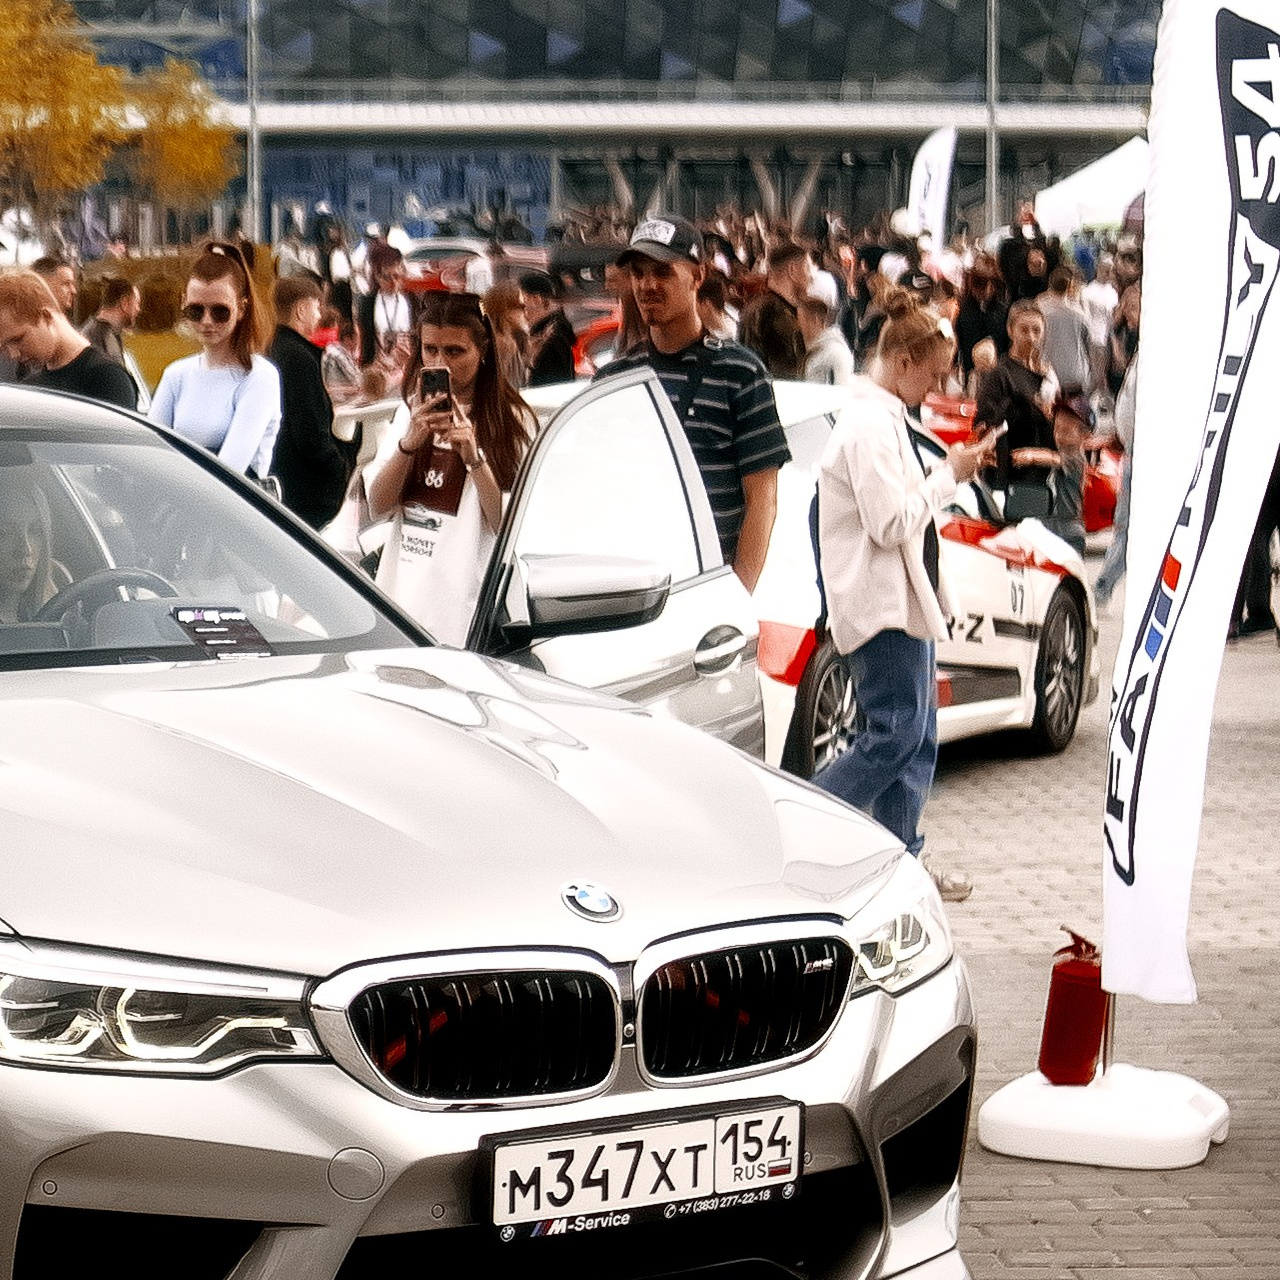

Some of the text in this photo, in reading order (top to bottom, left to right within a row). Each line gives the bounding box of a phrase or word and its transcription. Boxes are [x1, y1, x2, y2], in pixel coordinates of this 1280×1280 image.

[720, 1115, 787, 1165] 154
[733, 1163, 767, 1182] RUS
[678, 1203, 692, 1215] +7
[693, 1197, 720, 1213] (383)
[720, 1189, 771, 1208] 277-22-18
